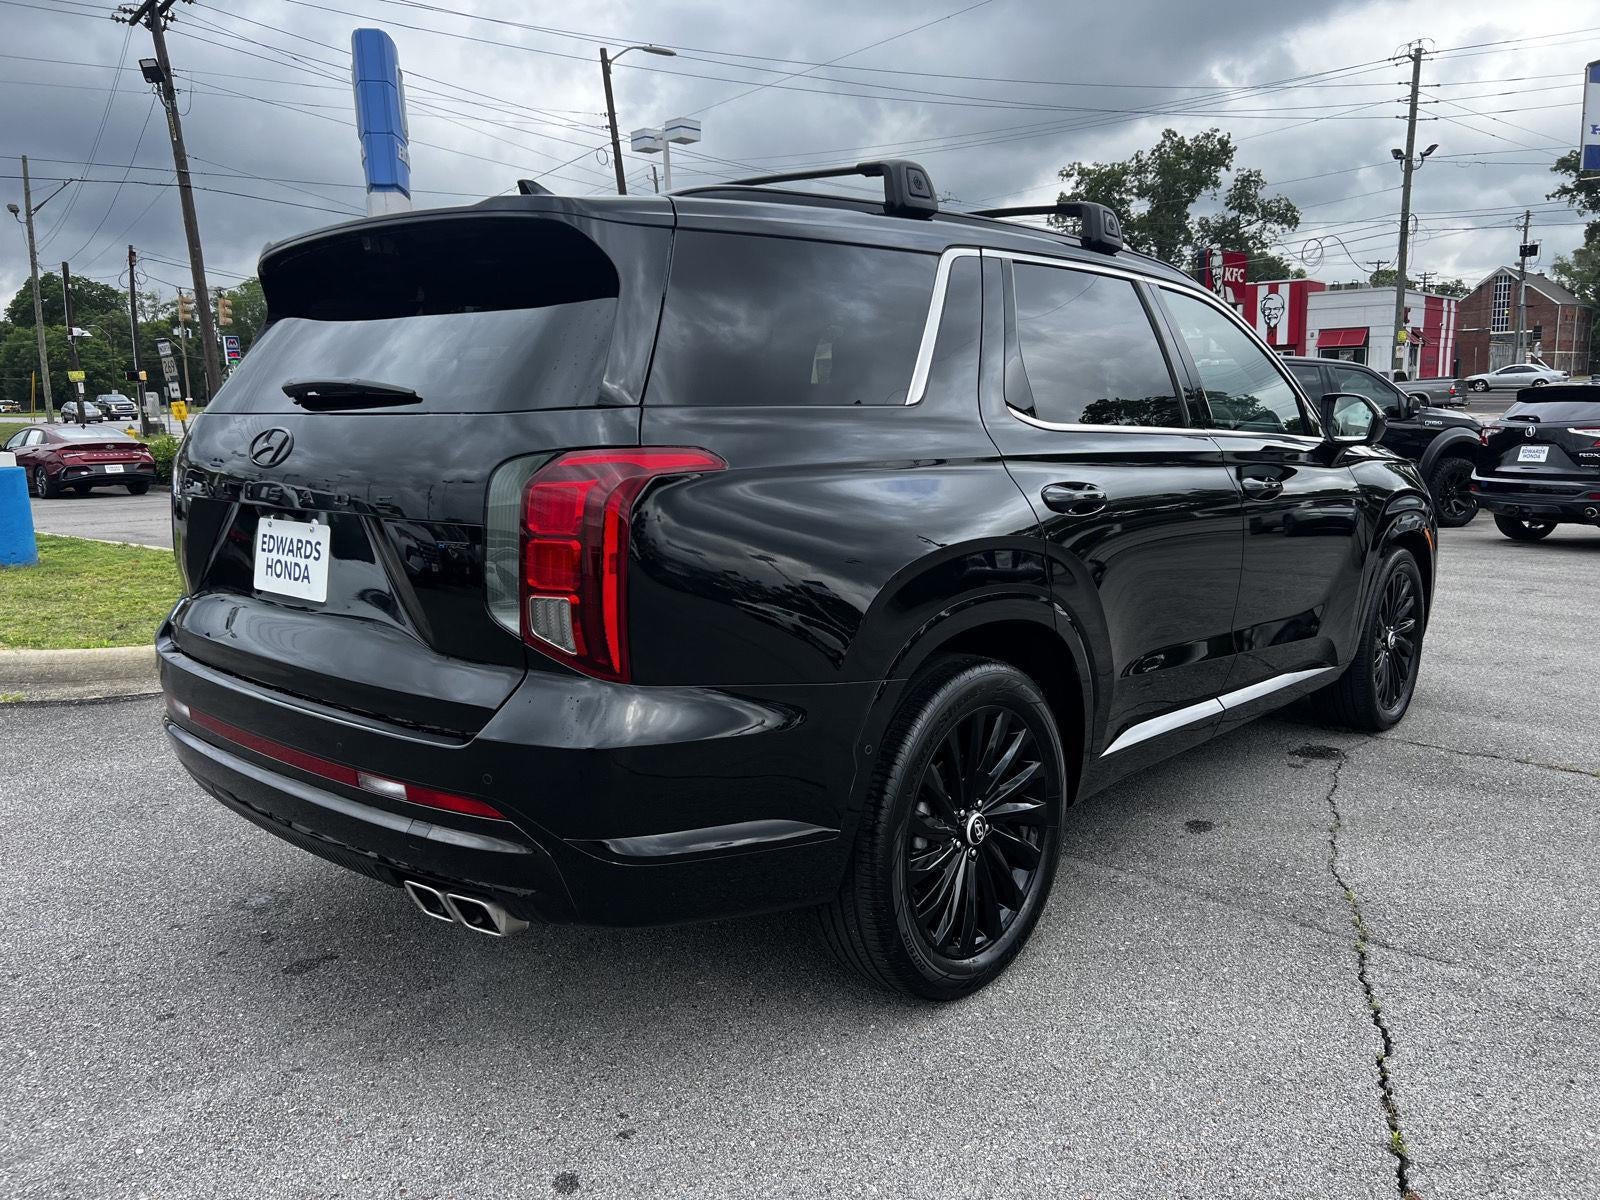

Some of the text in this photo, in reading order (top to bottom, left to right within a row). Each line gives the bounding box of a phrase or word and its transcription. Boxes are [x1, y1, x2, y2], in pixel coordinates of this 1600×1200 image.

[1224, 267, 1245, 283] KFC
[163, 360, 175, 374] 269
[261, 533, 322, 562] EDWARDS
[265, 557, 311, 585] HONDA
